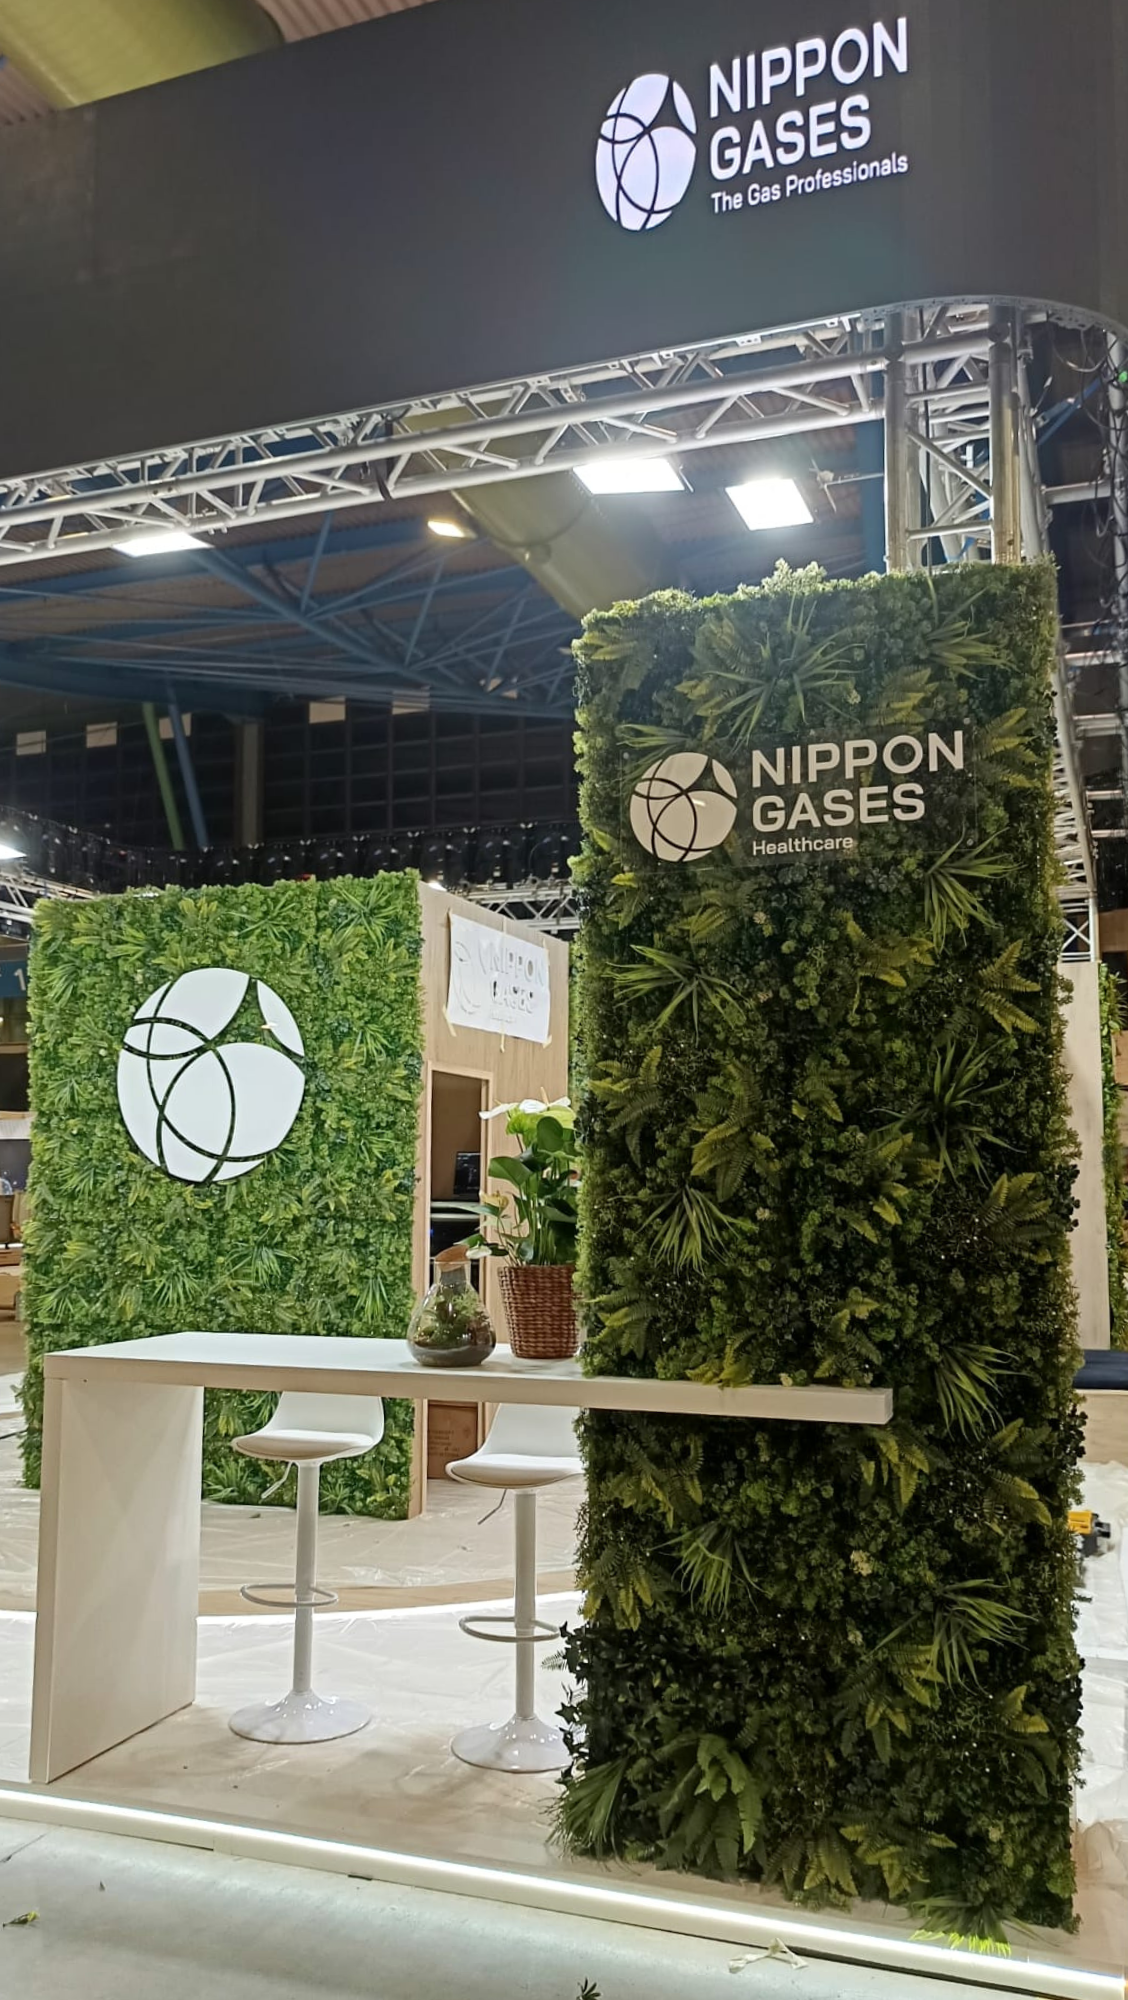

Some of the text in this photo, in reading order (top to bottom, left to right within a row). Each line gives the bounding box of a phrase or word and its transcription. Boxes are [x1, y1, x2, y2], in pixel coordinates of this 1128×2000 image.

[709, 17, 908, 118] NIPPON
[709, 94, 871, 181] GASES
[711, 152, 909, 214] The Gas Professionals
[752, 730, 964, 788] NIPPON
[752, 783, 926, 832] GASES
[752, 836, 854, 856] Healthcare
